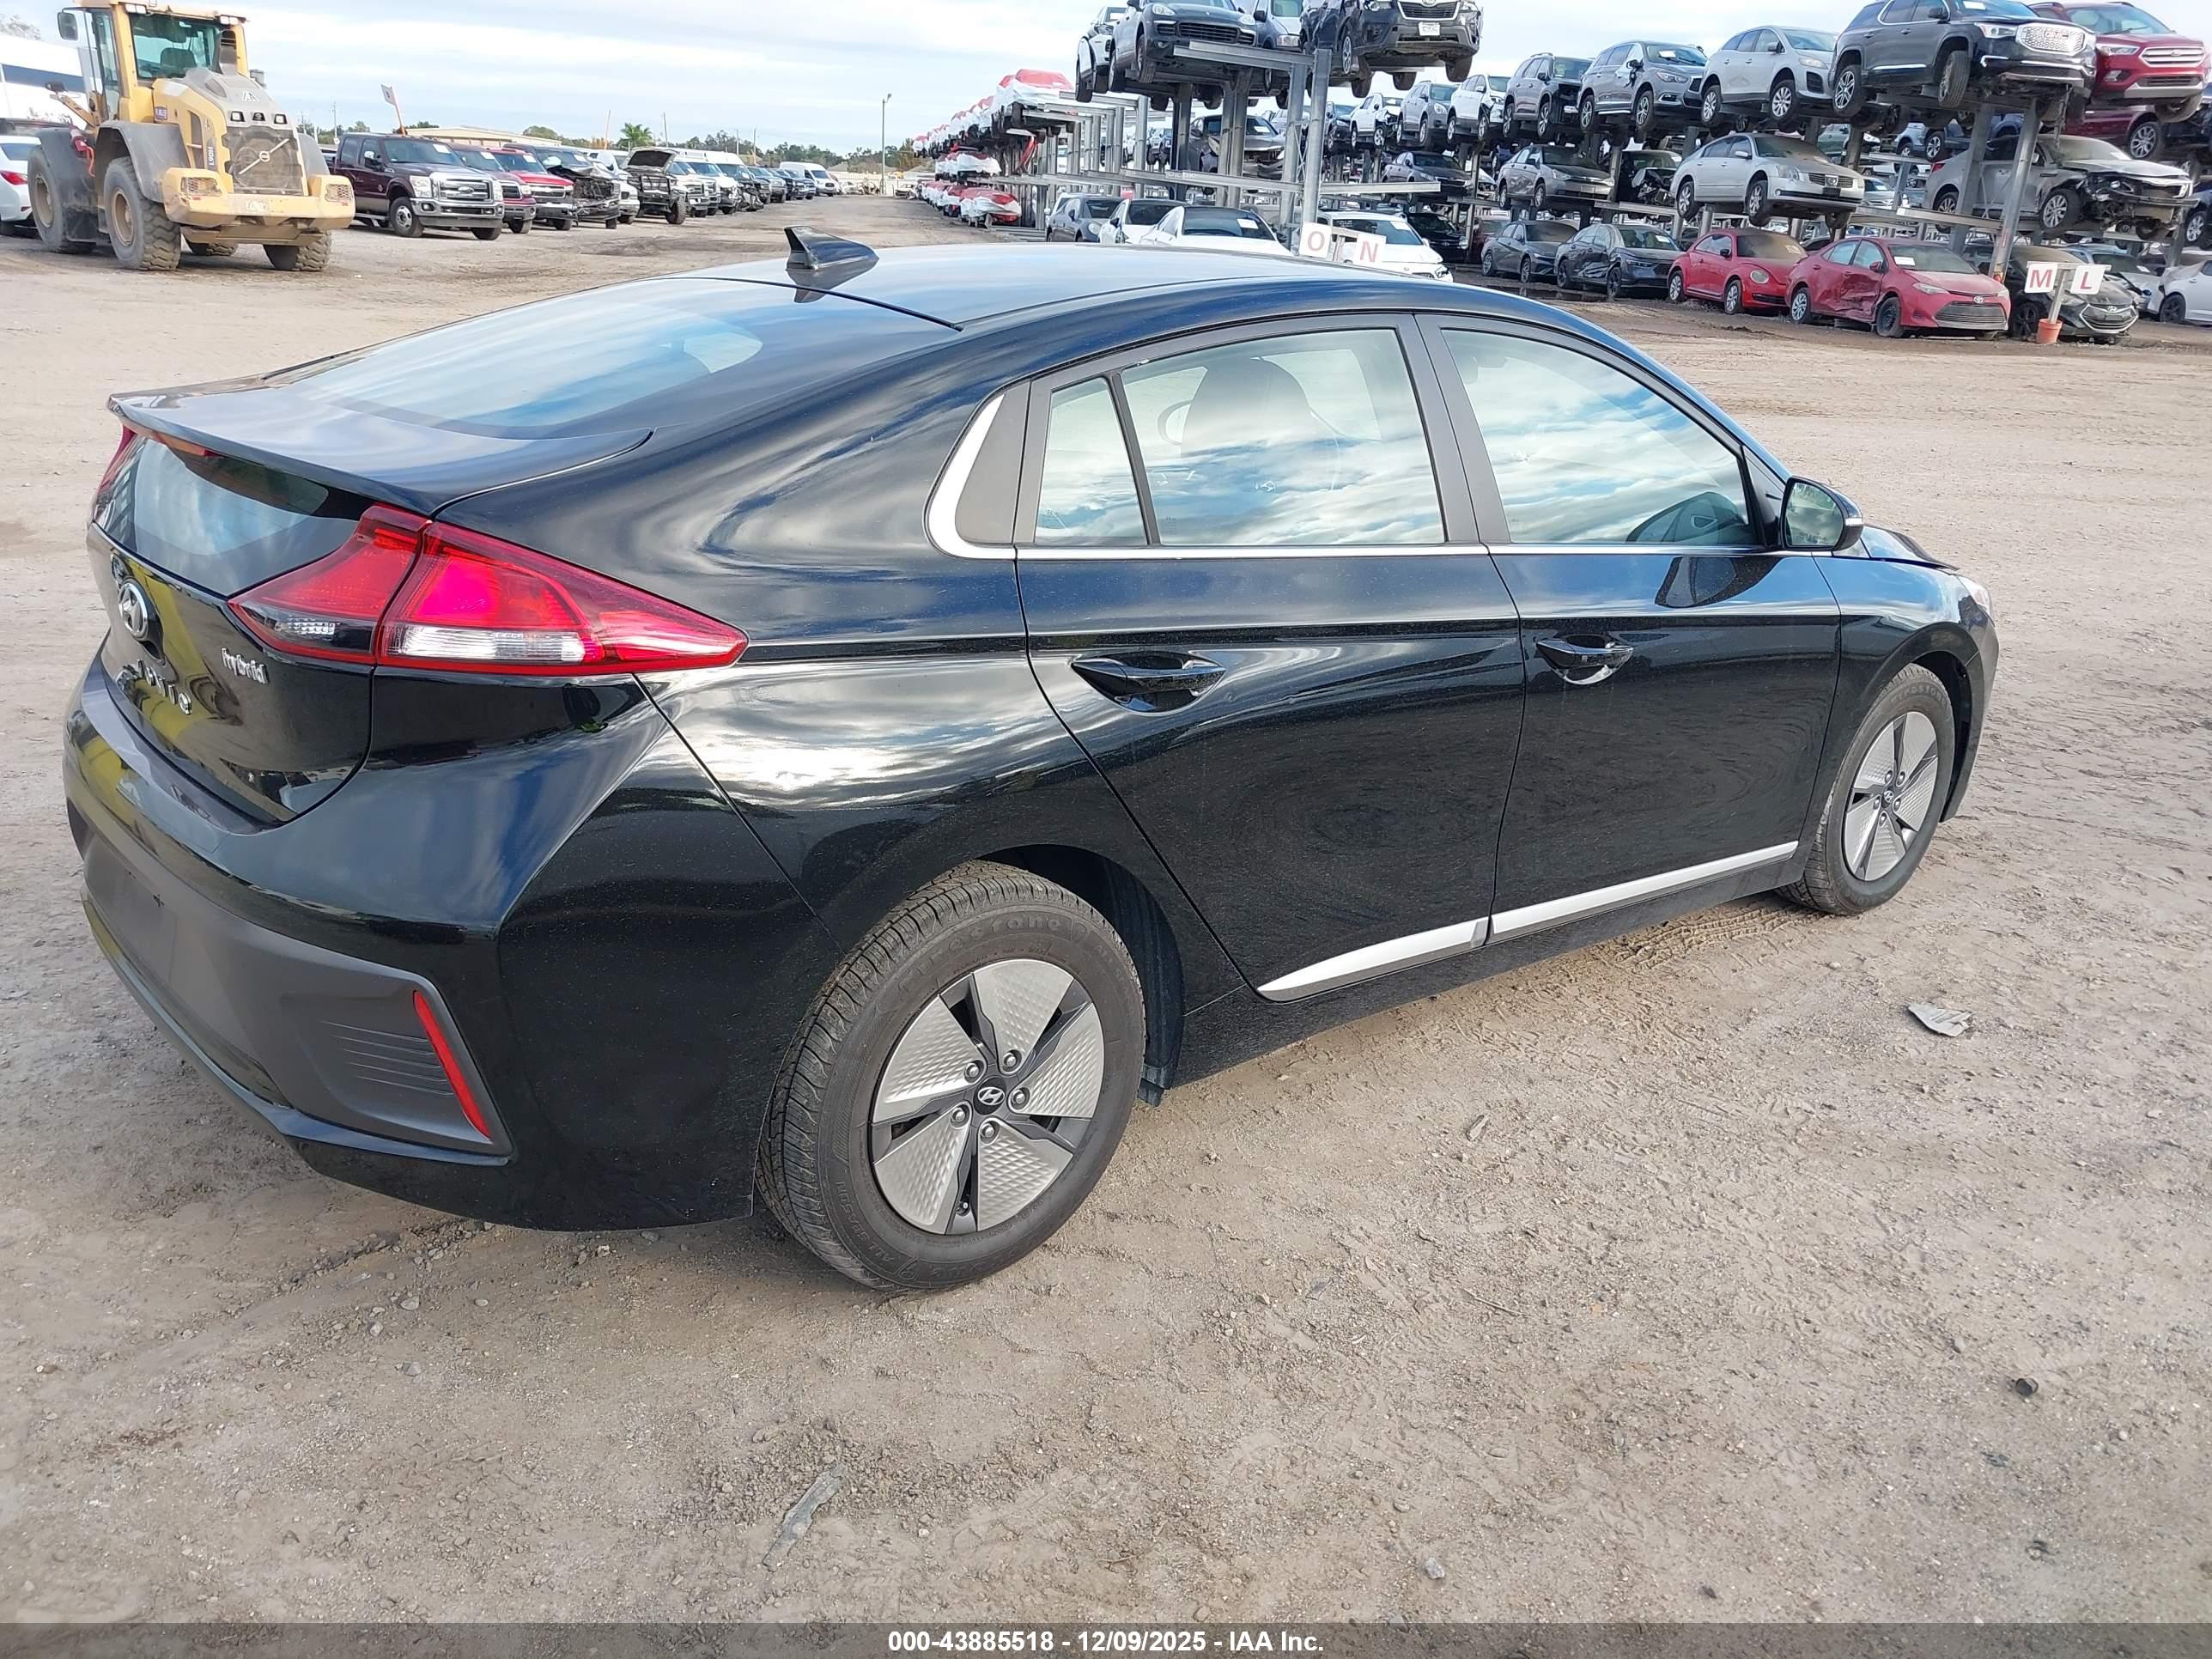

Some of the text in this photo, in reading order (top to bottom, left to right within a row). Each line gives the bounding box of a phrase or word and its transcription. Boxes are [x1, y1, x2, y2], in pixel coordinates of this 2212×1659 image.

[1307, 231, 1325, 251] O
[1360, 240, 1378, 263] N
[2029, 270, 2052, 289] M
[2080, 271, 2093, 290] L
